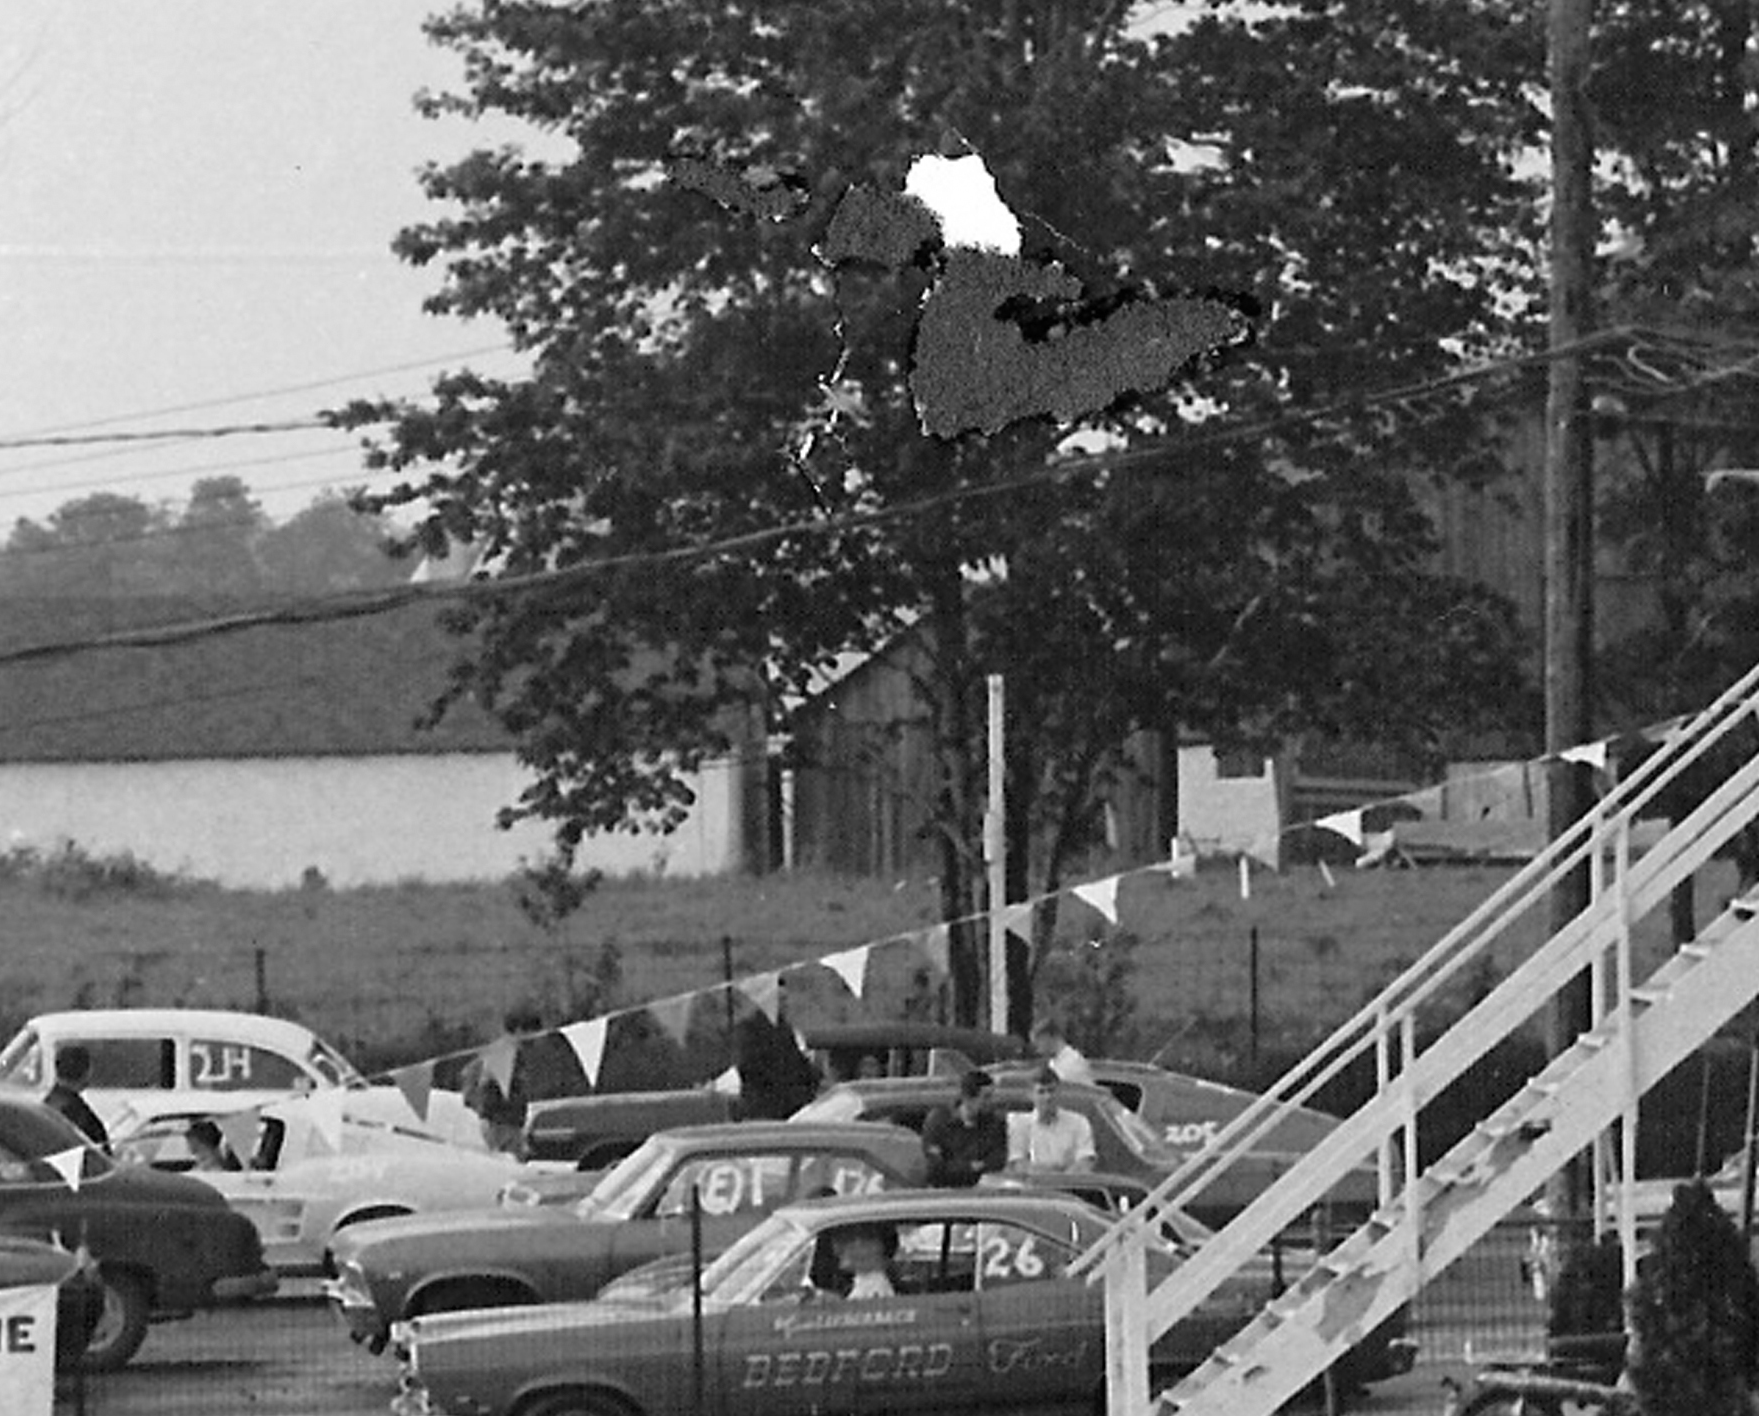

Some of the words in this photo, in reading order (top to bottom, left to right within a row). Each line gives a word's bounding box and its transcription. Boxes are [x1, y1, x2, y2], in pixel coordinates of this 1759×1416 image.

[983, 1236, 1044, 1278] 26
[742, 1342, 953, 1387] BEDFORD
[988, 1336, 1089, 1375] Ford
